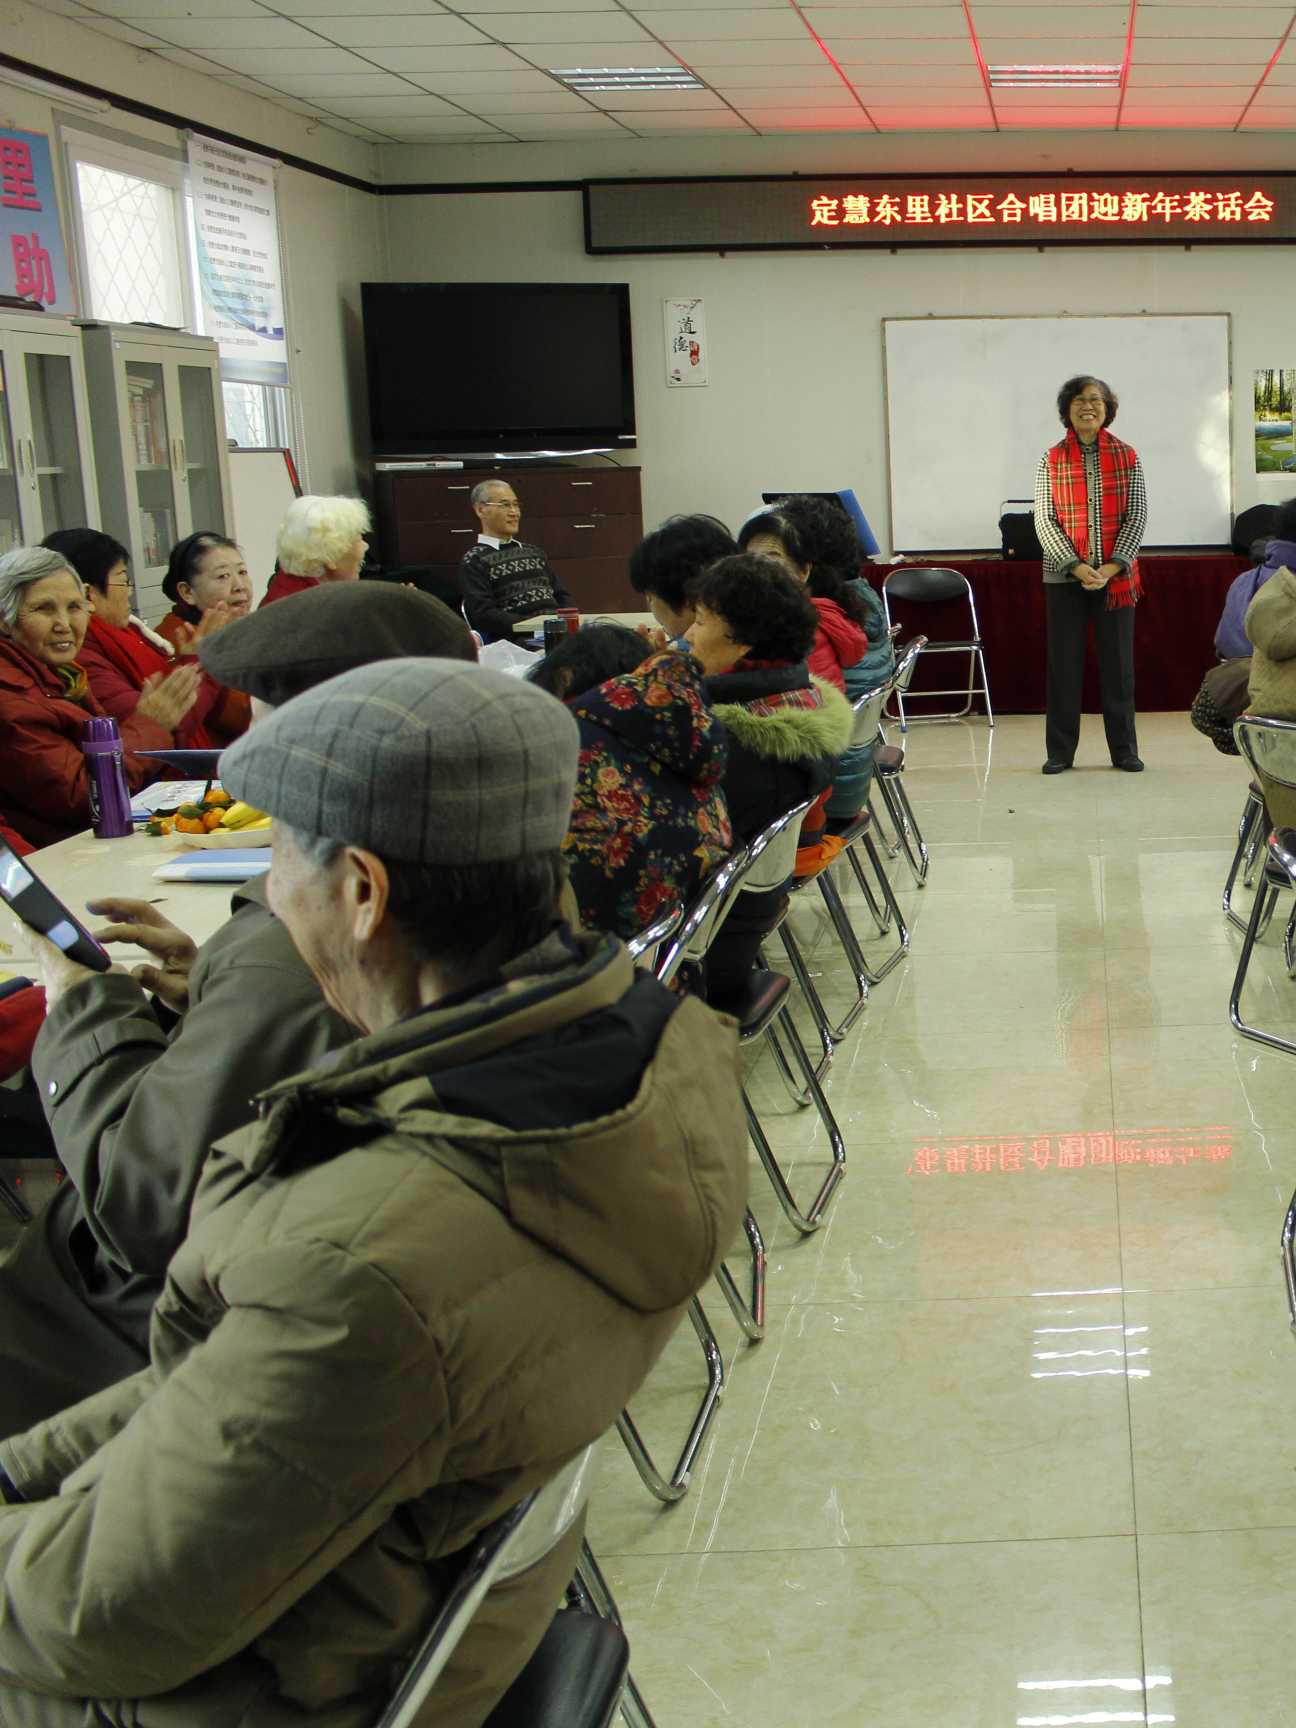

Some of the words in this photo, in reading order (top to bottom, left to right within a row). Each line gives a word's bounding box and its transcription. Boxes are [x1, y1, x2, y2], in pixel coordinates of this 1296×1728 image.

[0, 138, 42, 212] 里
[809, 191, 1276, 227] 定慧东里社区合唱团迎新年茶话会
[9, 231, 57, 306] 助
[672, 315, 697, 353] 道德
